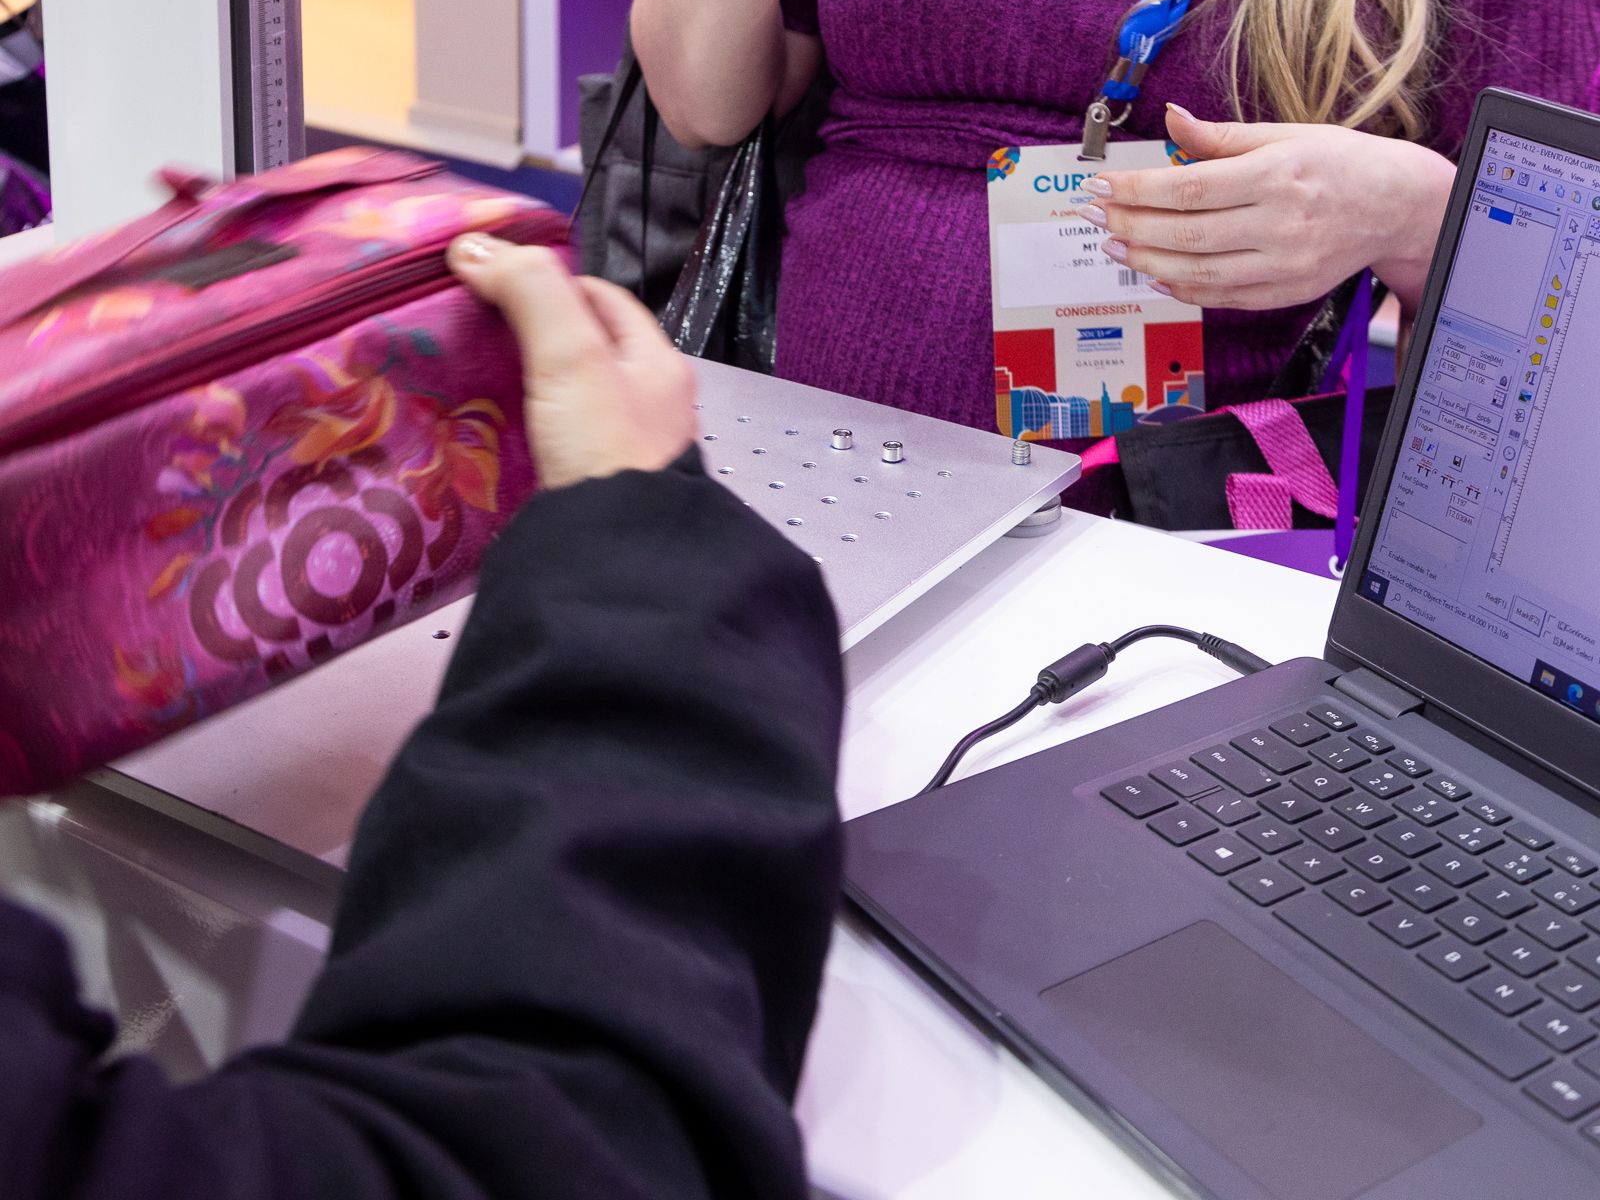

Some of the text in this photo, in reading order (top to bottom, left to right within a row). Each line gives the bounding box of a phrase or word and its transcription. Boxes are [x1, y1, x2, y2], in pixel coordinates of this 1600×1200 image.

[1540, 149, 1564, 162] EVENTO
[1488, 147, 1585, 183] File Edit Draw Modify View
[1033, 172, 1097, 193] CUR
[1477, 180, 1495, 193] Object
[1477, 193, 1532, 218] Name Type
[1050, 209, 1058, 217] A
[1515, 218, 1527, 228] Text
[1055, 304, 1142, 318] CONGRESSISTA
[1439, 317, 1451, 327] Text
[1429, 371, 1434, 379] Z
[1442, 398, 1455, 408] Input
[1456, 403, 1466, 412] Port
[1420, 406, 1431, 415] Font
[1476, 413, 1491, 424] Apply
[1417, 420, 1434, 432] Vogue
[1401, 471, 1413, 482] Text
[1412, 477, 1429, 490] Space
[1398, 483, 1414, 495] Height
[1395, 496, 1406, 507] Text
[1388, 550, 1405, 564] Enable
[1426, 569, 1437, 580] Text
[1405, 582, 1423, 595] object
[1405, 600, 1436, 623] Pesquisar
[1326, 711, 1340, 720] esc
[1251, 736, 1265, 746] tab
[1211, 752, 1226, 763] fixa
[1170, 767, 1189, 780] shift
[1314, 777, 1328, 787] Q
[1369, 778, 1381, 786] 2
[1125, 784, 1141, 795] ctrl
[1281, 799, 1296, 808] A
[1356, 802, 1373, 813] W
[1177, 820, 1188, 829] fn
[1261, 829, 1278, 838] Z
[1325, 826, 1340, 835] S
[1400, 831, 1416, 841] E
[1304, 858, 1321, 868] X
[1368, 854, 1383, 864] D
[1445, 860, 1461, 870] R
[1504, 861, 1518, 869] 5
[1350, 888, 1366, 898] C
[1415, 884, 1431, 894] F
[1496, 890, 1511, 899] T
[1554, 891, 1568, 900] 6
[1398, 919, 1414, 929] V
[1462, 915, 1480, 927] G
[1546, 921, 1561, 931] Y
[1444, 951, 1462, 963] B
[1512, 947, 1531, 960] H
[1494, 984, 1515, 998] N
[1565, 983, 1583, 993] J
[1546, 1018, 1571, 1036] M
